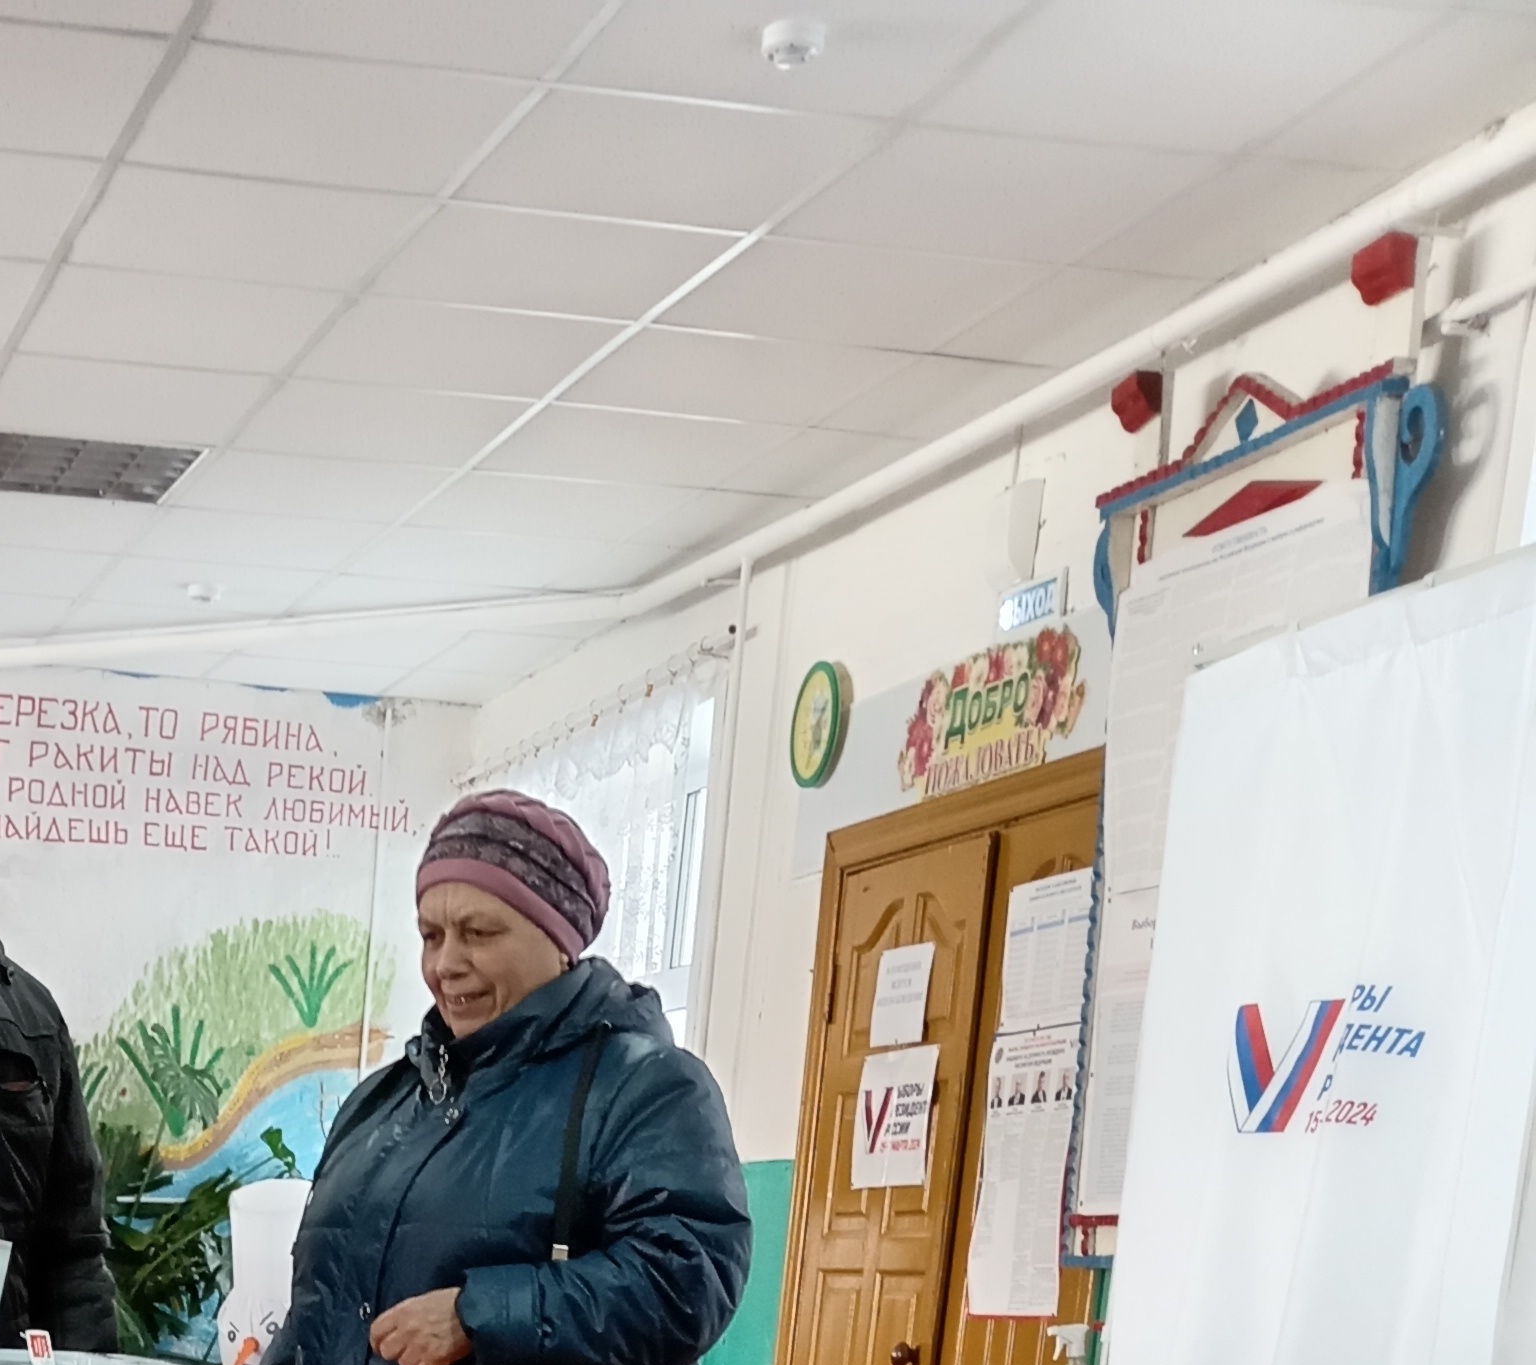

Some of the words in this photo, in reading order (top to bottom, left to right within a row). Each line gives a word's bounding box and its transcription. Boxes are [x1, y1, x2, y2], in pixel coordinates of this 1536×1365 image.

[1000, 582, 1056, 630] ЫХОД
[138, 706, 178, 740] ТО
[944, 671, 1030, 750] ДОБРО
[29, 740, 173, 778] РАКИТЫ
[191, 754, 251, 788] НАД
[8, 777, 126, 810] РОДНОЙ
[144, 787, 242, 818] НАВЕК
[264, 797, 417, 837] ЛЮБИМЫЙ,
[144, 822, 207, 852] ЕЩЕ
